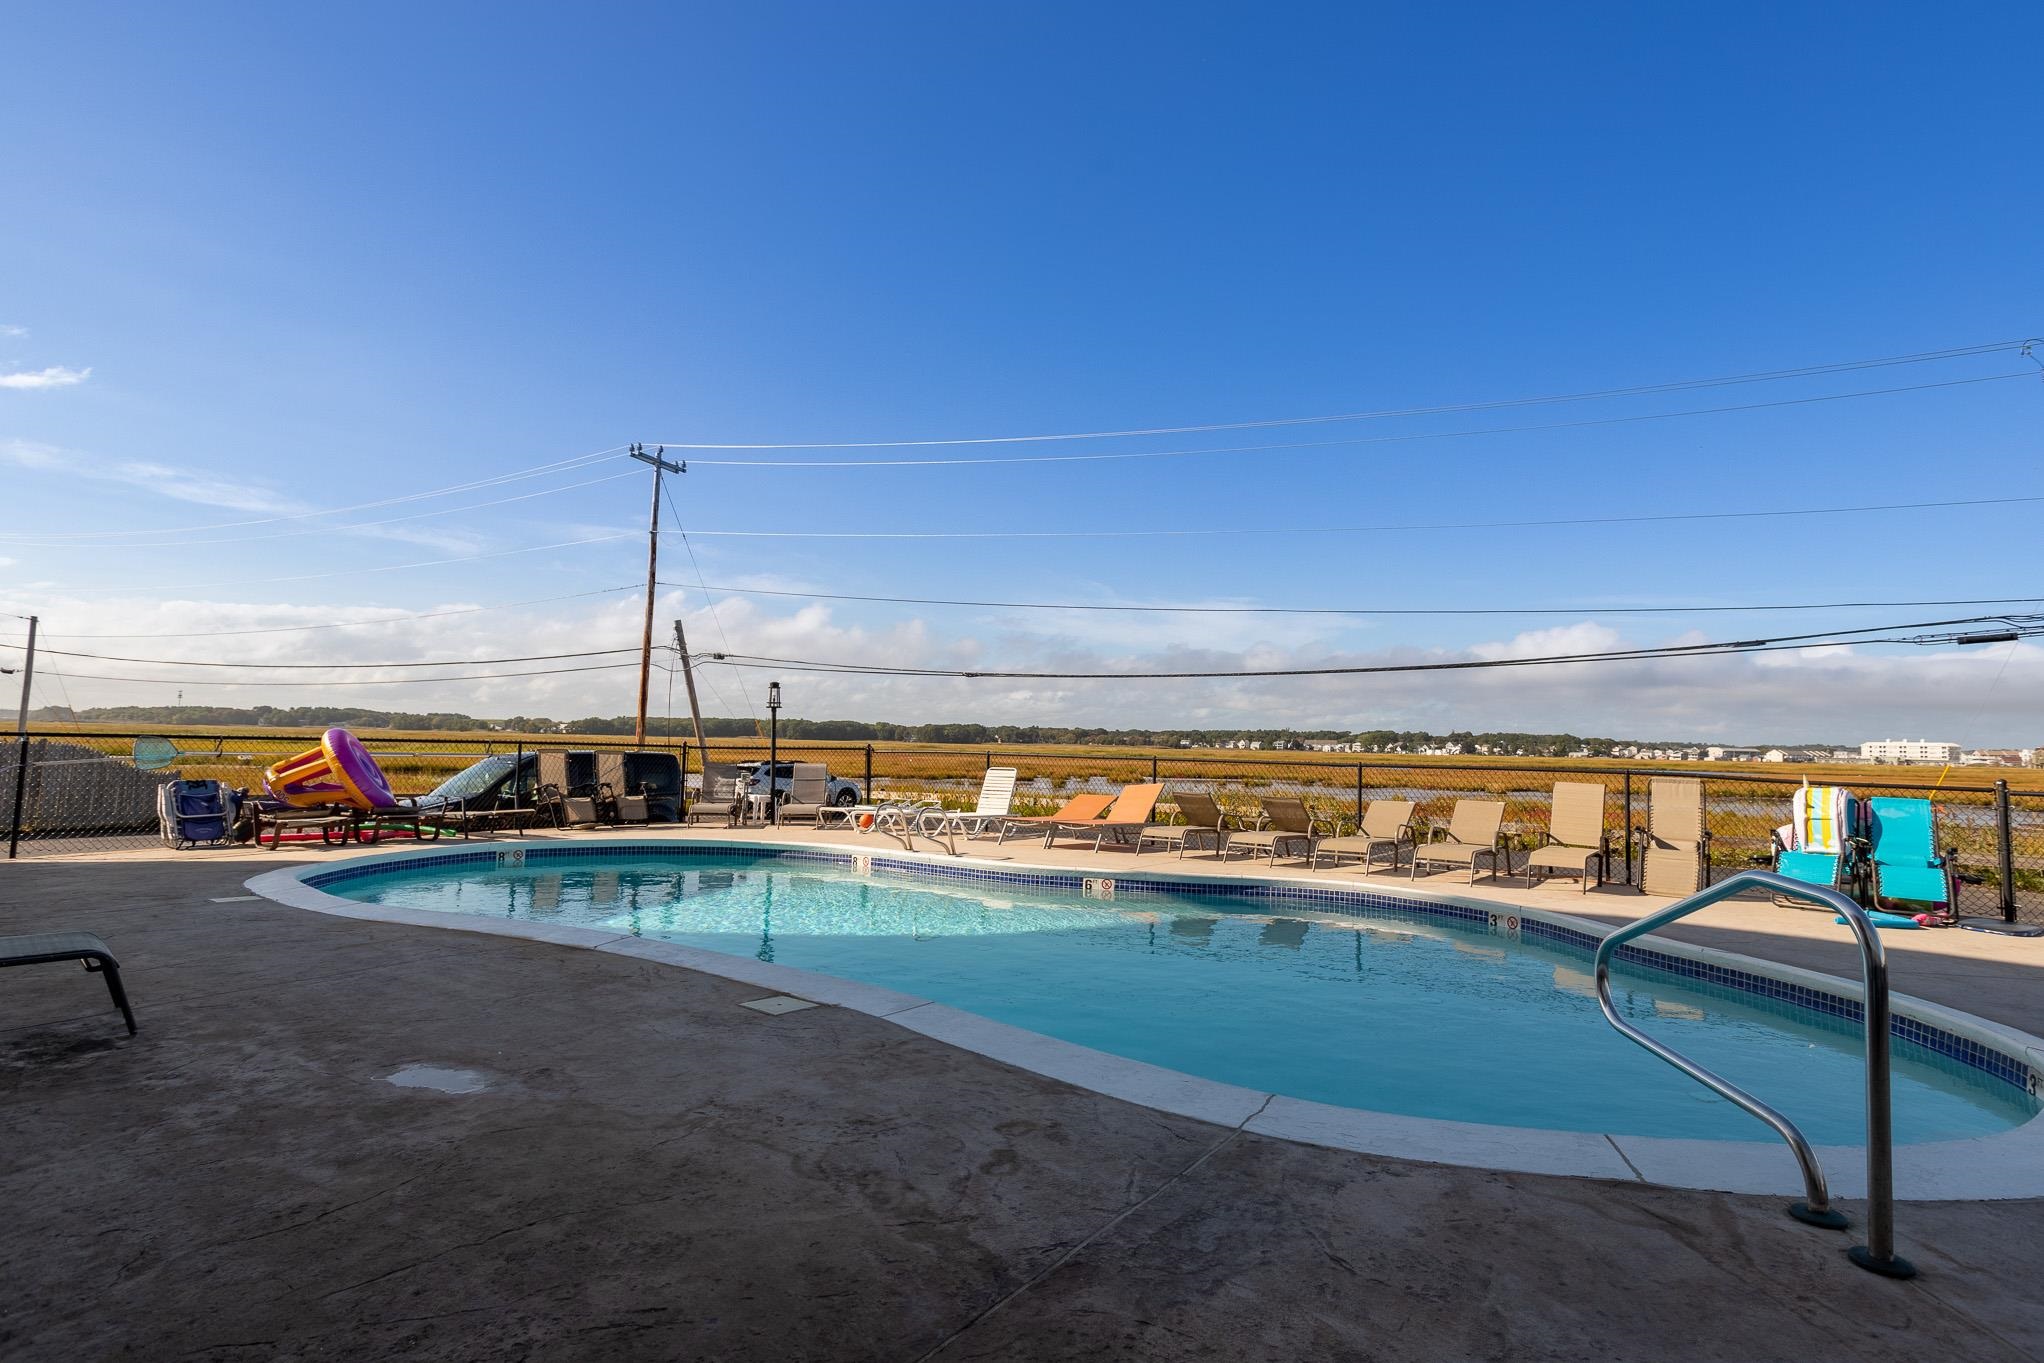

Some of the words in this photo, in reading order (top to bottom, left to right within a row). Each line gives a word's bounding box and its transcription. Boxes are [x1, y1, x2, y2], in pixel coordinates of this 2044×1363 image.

[498, 852, 504, 862] 8
[1085, 880, 1092, 889] 6
[1490, 914, 1497, 926] 3
[2029, 1074, 2036, 1096] 3
